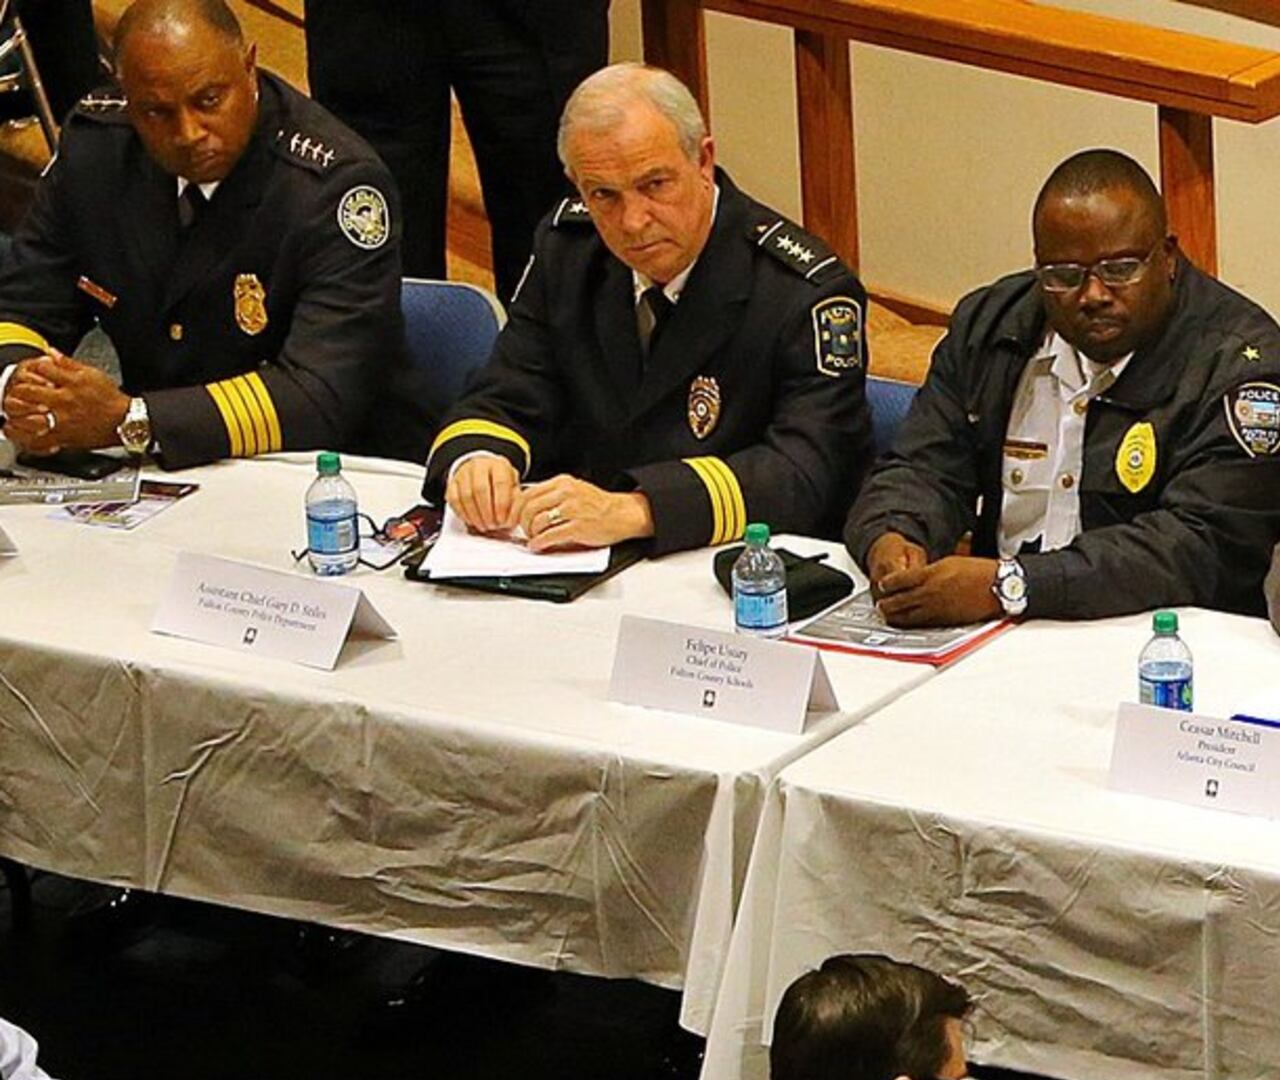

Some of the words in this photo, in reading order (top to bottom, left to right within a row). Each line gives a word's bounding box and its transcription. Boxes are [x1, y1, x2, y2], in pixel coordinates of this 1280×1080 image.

[825, 353, 859, 368] POLIC
[1239, 389, 1279, 401] POLICE
[240, 591, 266, 606] Chief
[265, 597, 289, 614] Gary
[198, 598, 221, 610] Fulton
[224, 602, 250, 617] County
[251, 609, 273, 622] Police
[274, 614, 318, 631] Department
[686, 638, 718, 656] Felipe
[686, 655, 708, 670] Chief
[719, 659, 742, 675] Police
[670, 666, 695, 681] Fulton
[697, 670, 725, 687] County
[726, 675, 754, 690] Schools
[1217, 726, 1261, 745] Mitchell
[1198, 740, 1235, 754] President
[1178, 751, 1204, 764] Atlanta
[1205, 755, 1223, 769] City
[1223, 758, 1256, 772] Council
